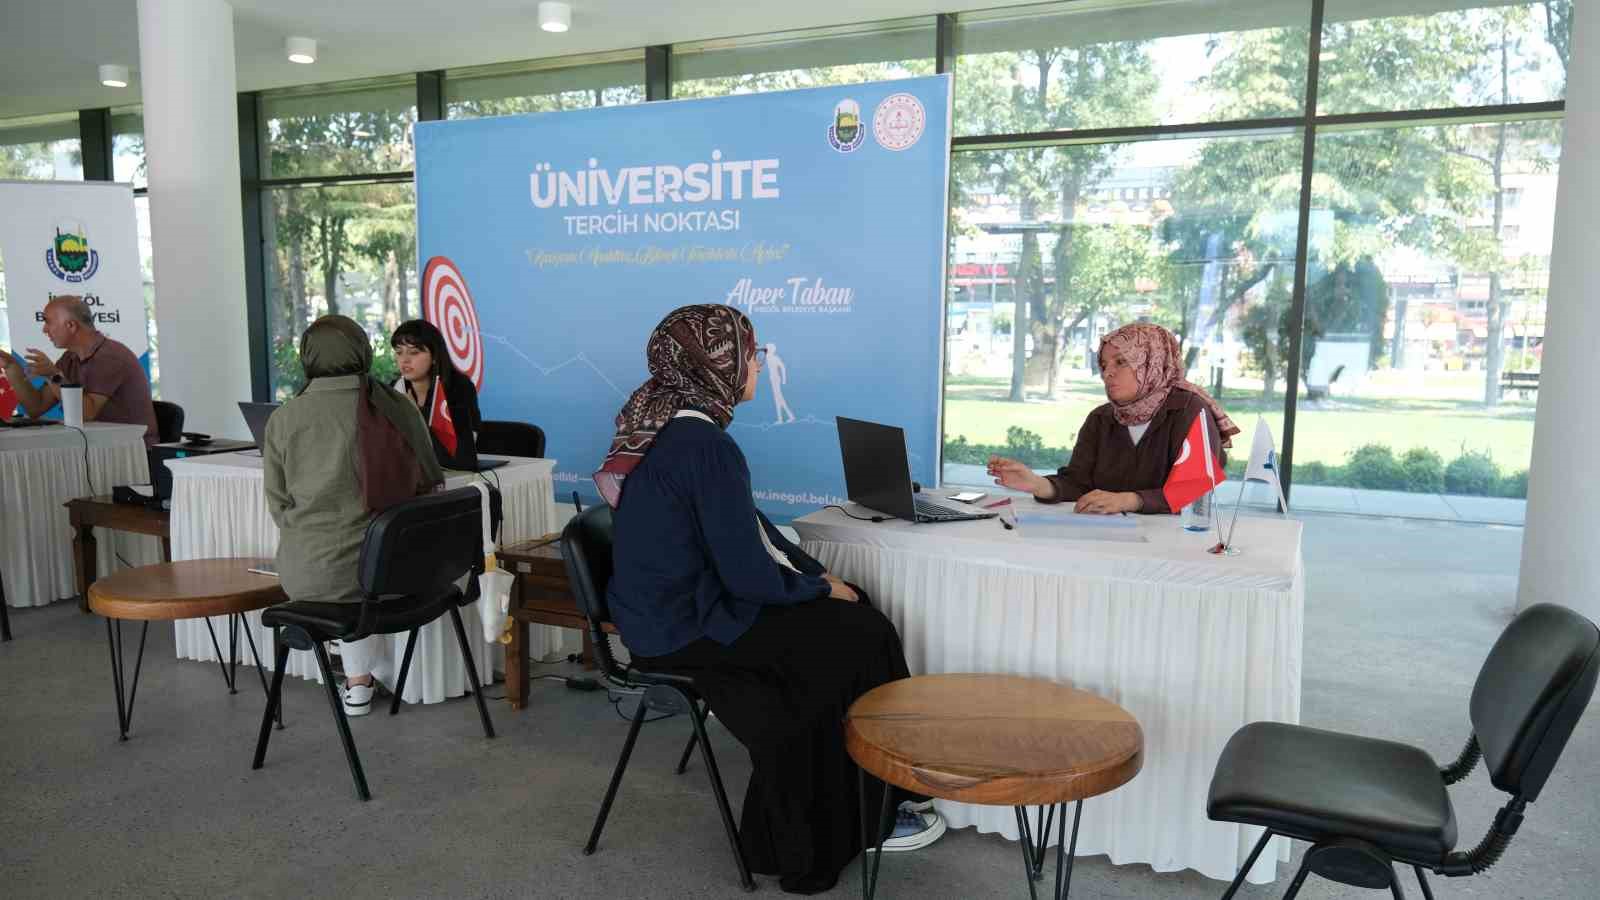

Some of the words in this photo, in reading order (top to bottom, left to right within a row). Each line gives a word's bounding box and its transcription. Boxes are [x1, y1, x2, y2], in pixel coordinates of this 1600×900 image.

[529, 149, 780, 208] ÜNİVERSİTE
[564, 209, 639, 235] TERCİH
[644, 209, 740, 233] NOKTASI
[725, 277, 784, 315] Alper
[786, 277, 854, 305] Taban
